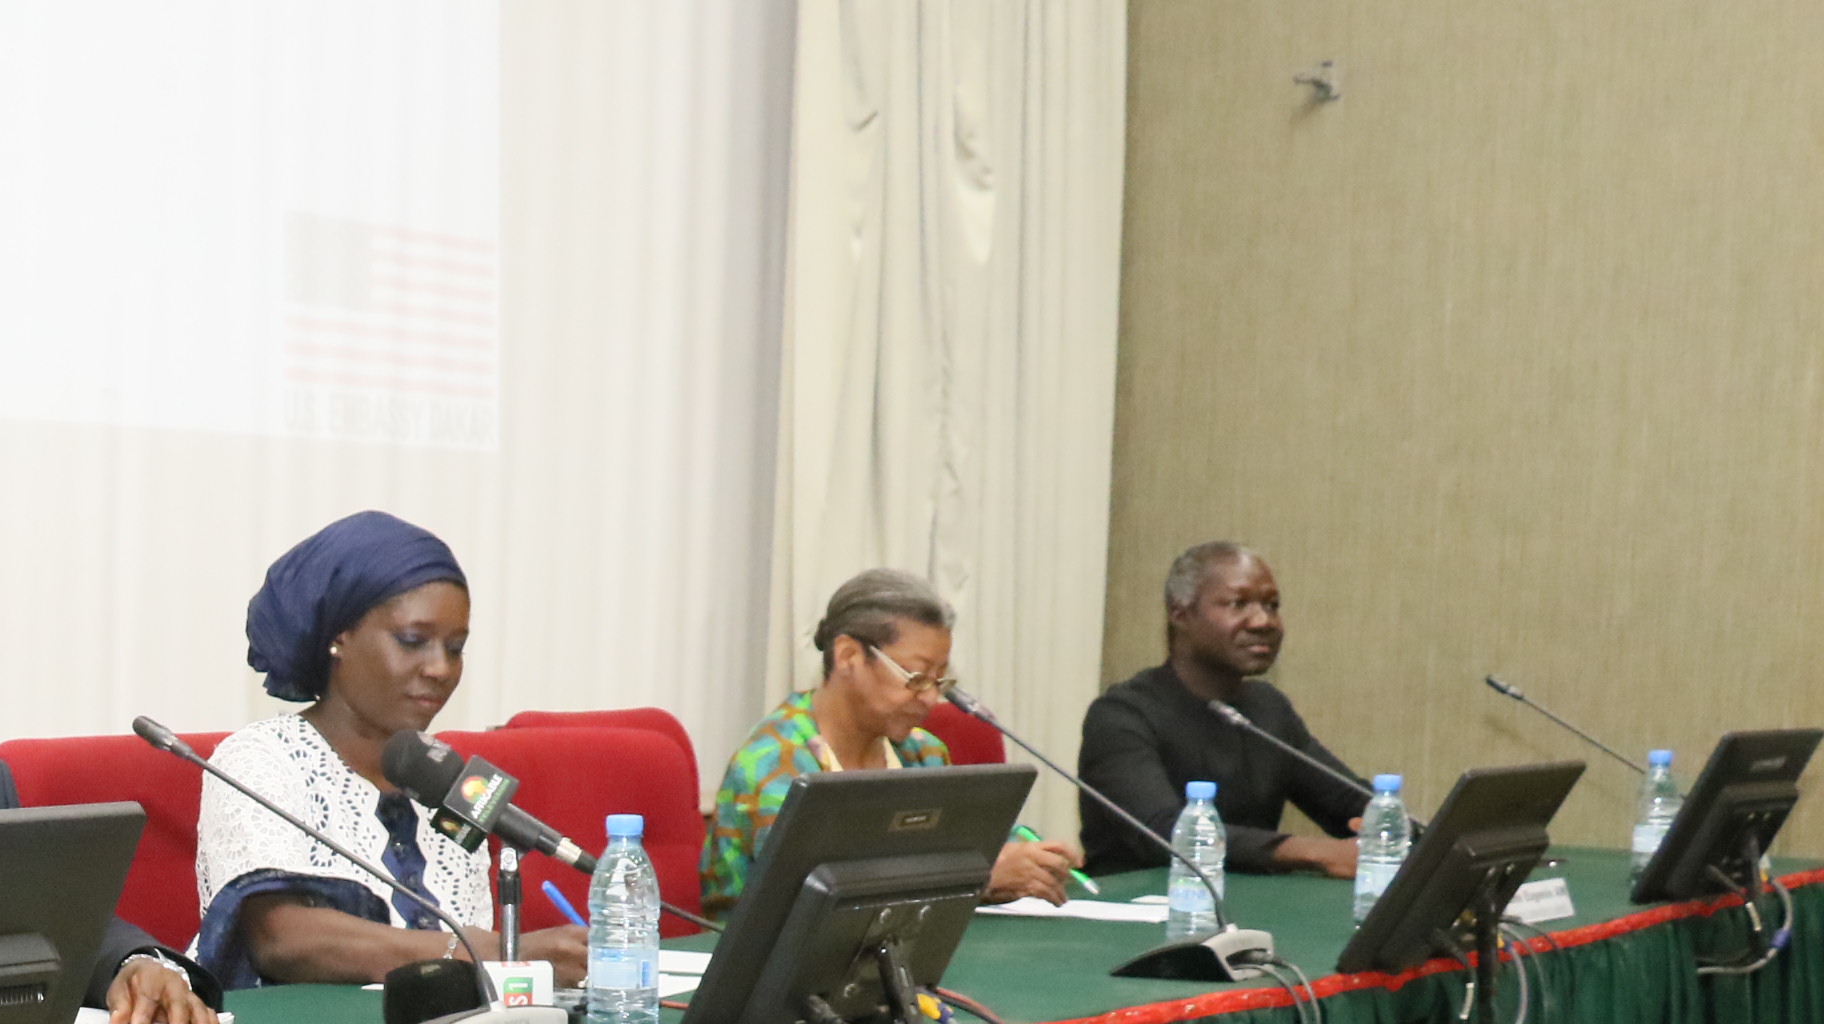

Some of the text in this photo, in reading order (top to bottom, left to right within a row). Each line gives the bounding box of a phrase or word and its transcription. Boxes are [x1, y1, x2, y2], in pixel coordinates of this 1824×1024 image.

[328, 392, 425, 440] EMBASSY
[429, 398, 496, 446] DAKAR
[470, 773, 503, 819] AFRICABLE
